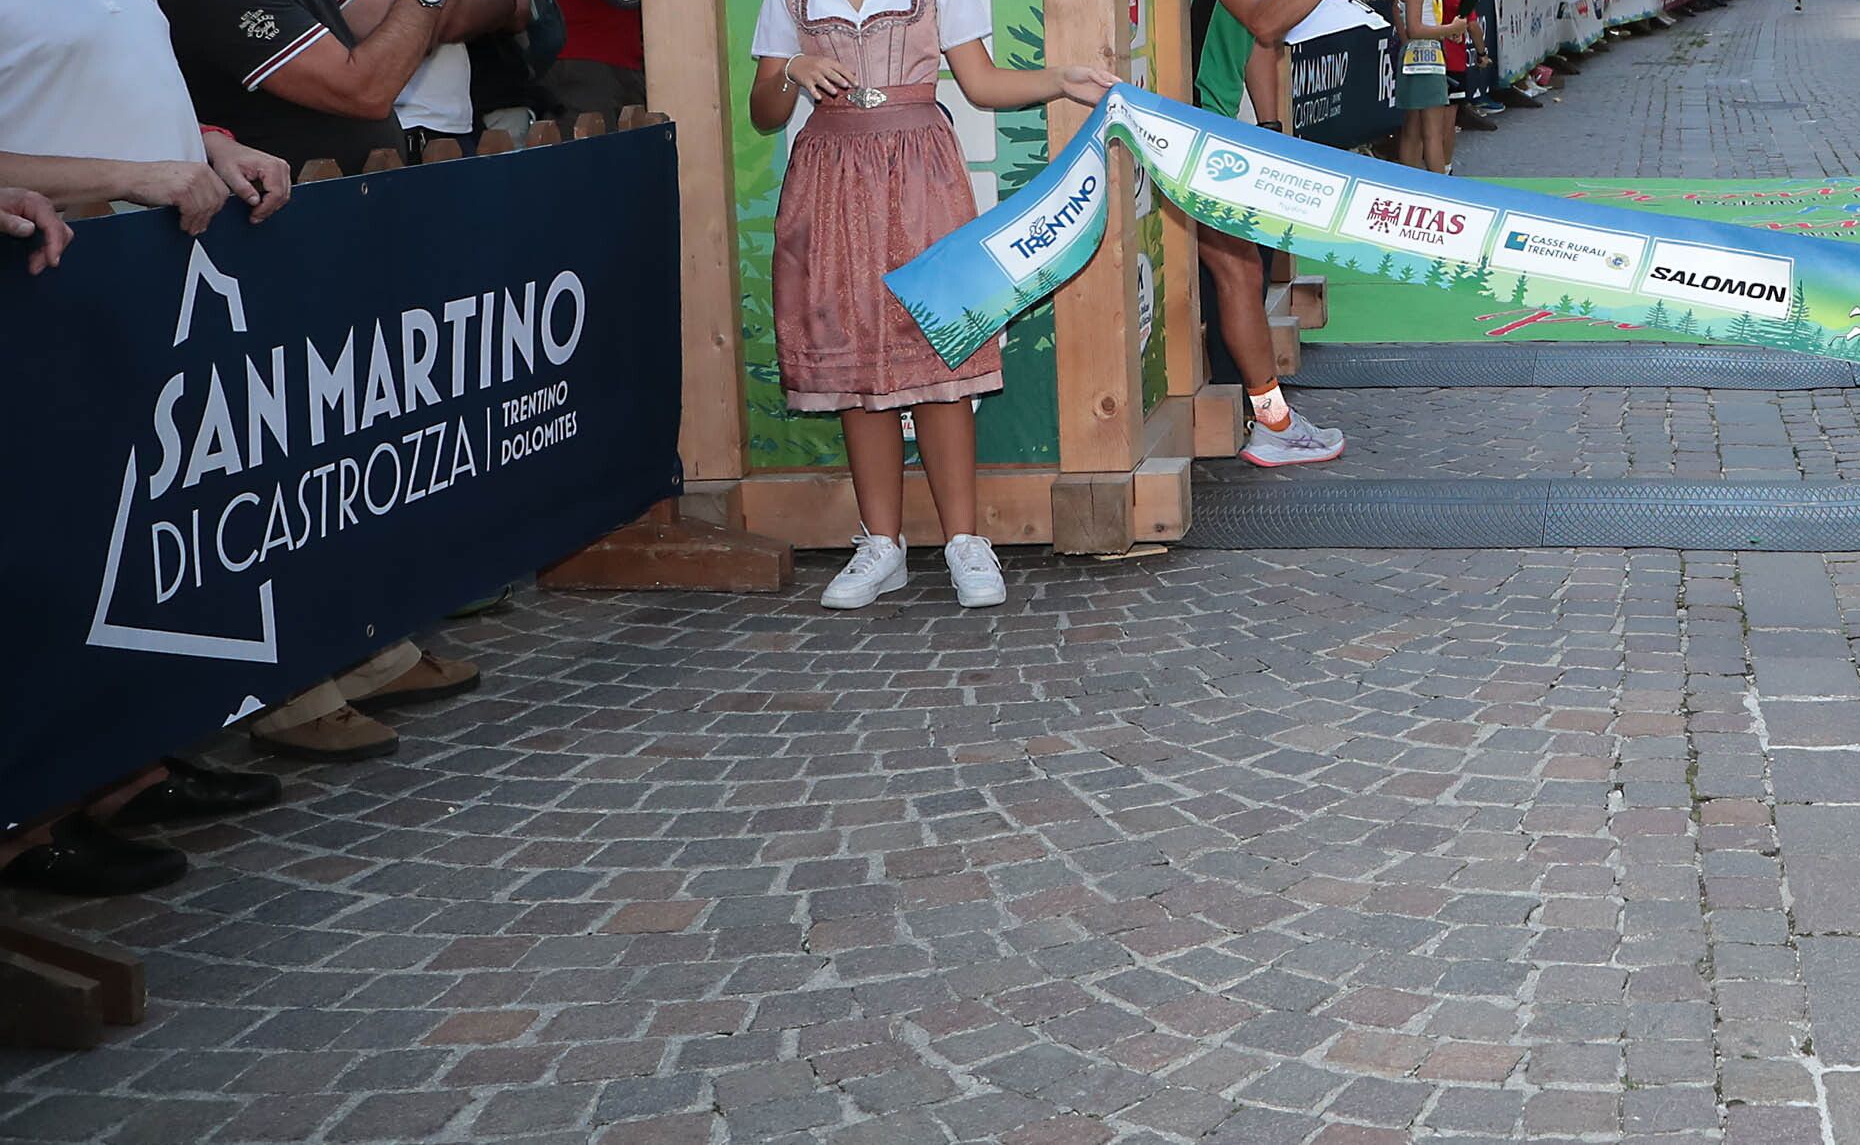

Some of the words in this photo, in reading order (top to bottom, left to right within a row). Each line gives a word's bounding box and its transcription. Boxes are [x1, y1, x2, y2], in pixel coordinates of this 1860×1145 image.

[1306, 51, 1349, 95] MARTINO
[1412, 50, 1437, 62] 3186
[1254, 179, 1321, 208] ENERGIA
[1260, 167, 1335, 197] PRIMIERO
[1011, 176, 1097, 262] TRENTINO
[1406, 205, 1466, 235] ITAS
[1398, 228, 1445, 245] MUTUA
[1531, 234, 1564, 251] CASSE
[1567, 241, 1606, 258] RURALI
[1527, 245, 1578, 263] TRENTINE
[1649, 266, 1787, 304] SALOMON
[150, 346, 289, 500] SAN
[307, 270, 586, 446] MARTINO
[502, 380, 568, 427] TRENTINO
[500, 410, 578, 466] DOLOMITES
[152, 509, 201, 605] DI
[216, 415, 476, 572] CASTROZZA
